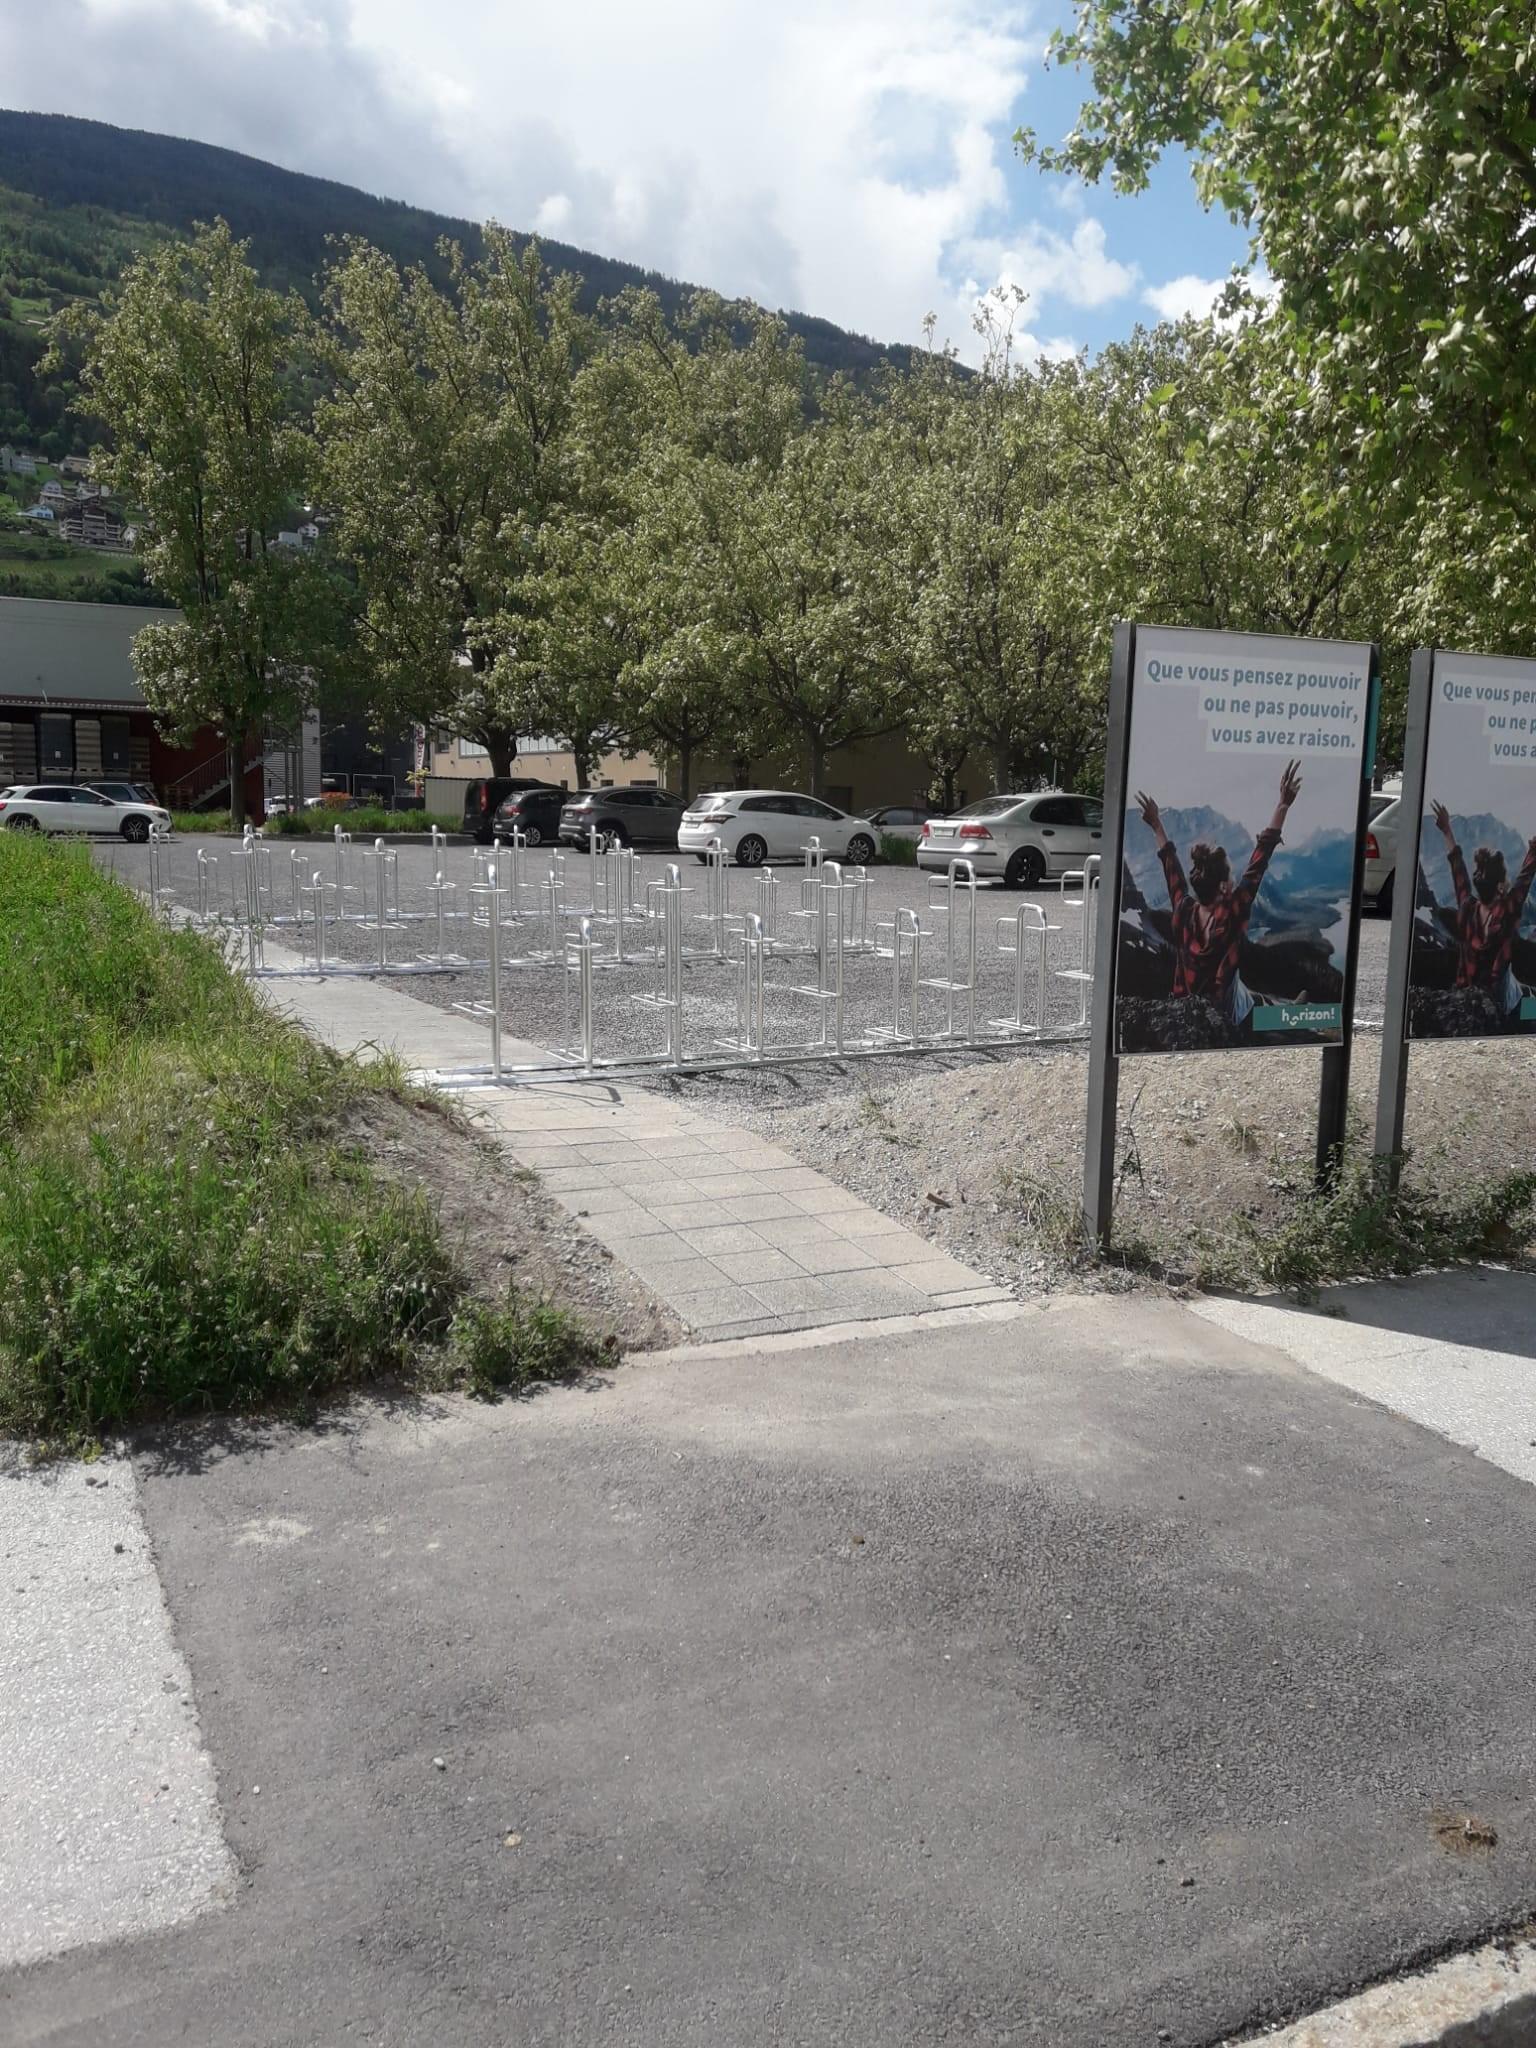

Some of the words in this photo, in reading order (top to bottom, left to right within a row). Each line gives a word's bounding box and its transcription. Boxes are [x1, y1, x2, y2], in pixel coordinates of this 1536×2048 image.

[1147, 659, 1183, 683] Que
[1188, 665, 1229, 682] vous
[1233, 668, 1293, 687] pensez
[1296, 671, 1361, 690] pouvoir
[1443, 681, 1472, 702] Que
[1476, 687, 1510, 702] vous
[1204, 698, 1226, 712] ou
[1230, 699, 1251, 713] ne
[1255, 700, 1285, 718] pas
[1288, 700, 1358, 724] pouvoir,
[1488, 715, 1506, 728] ou
[1509, 716, 1527, 730] ne
[1212, 728, 1253, 743] vous
[1256, 729, 1296, 745] avez
[1299, 727, 1356, 748] raison.
[1494, 743, 1527, 757] vous
